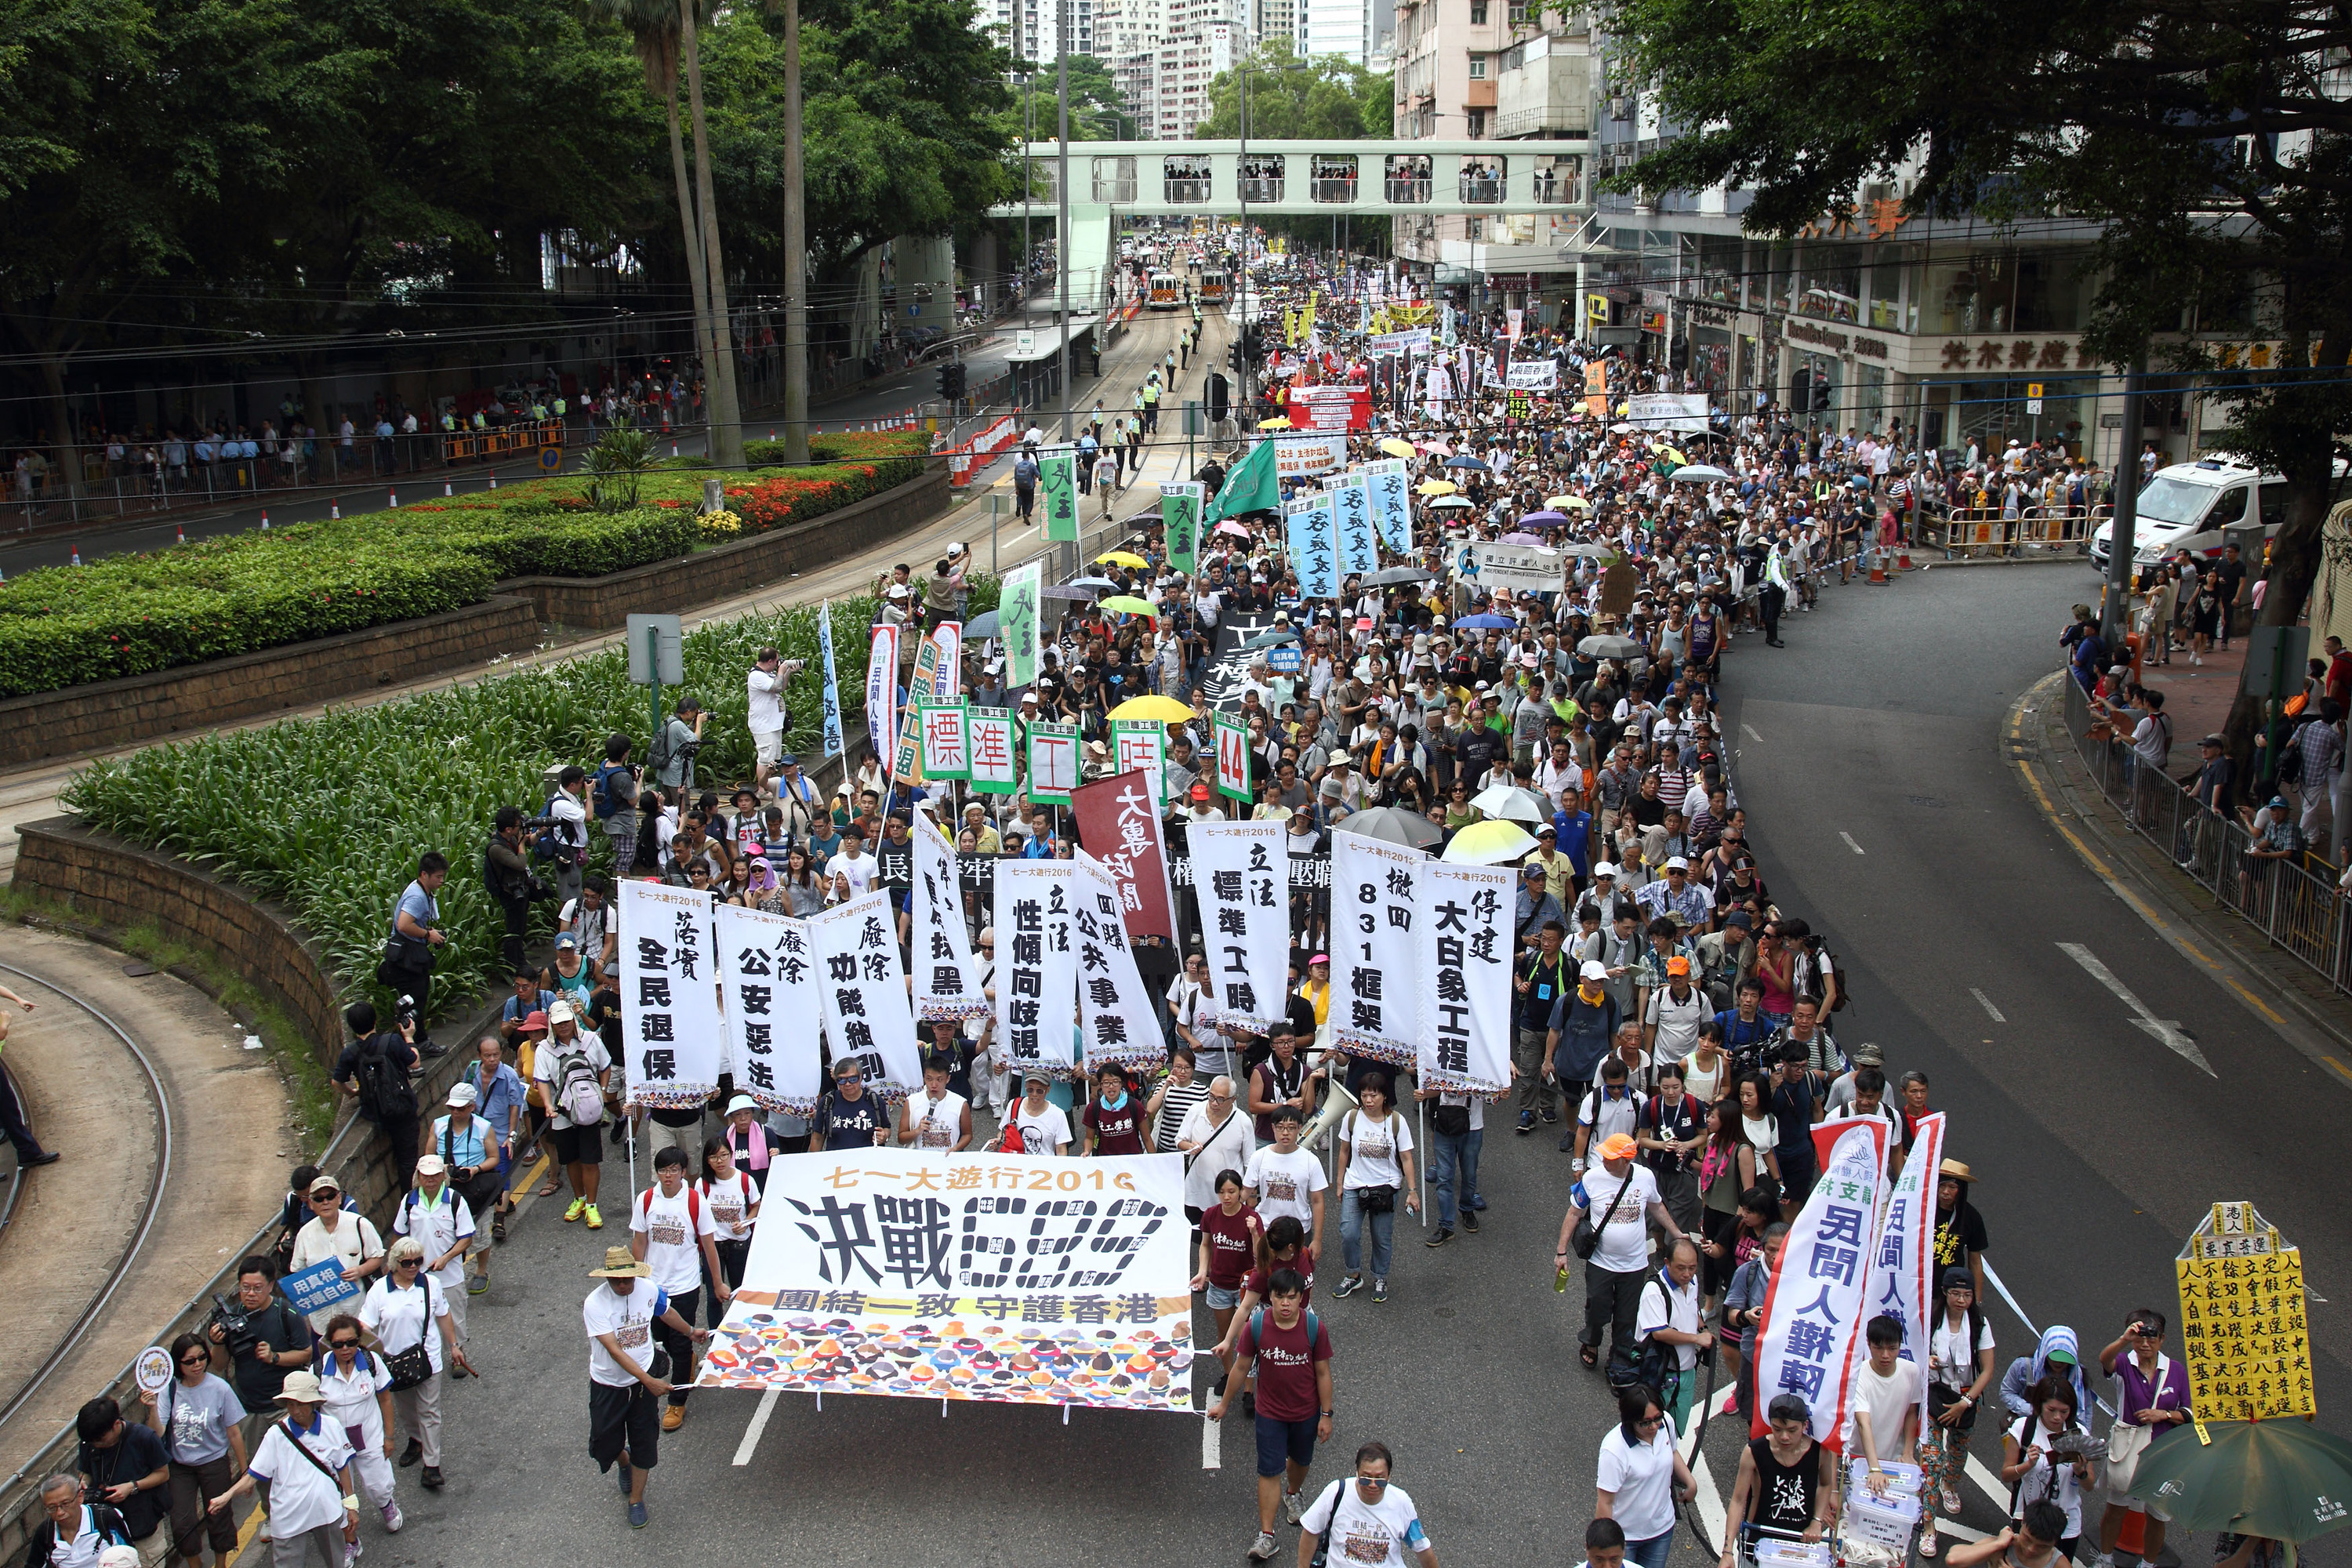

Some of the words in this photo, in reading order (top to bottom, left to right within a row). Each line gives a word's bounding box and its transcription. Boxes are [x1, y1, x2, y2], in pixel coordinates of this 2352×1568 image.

[1273, 652, 1295, 661] 用真相
[934, 695, 963, 706] 職工盟
[980, 707, 1008, 718] 職工盟
[1225, 715, 1245, 729] 職工盟
[926, 712, 963, 766] 標
[1045, 724, 1076, 735] 職工盟
[1130, 720, 1160, 731] 職工盟
[972, 722, 1008, 776] 準
[1036, 738, 1072, 790] 工
[1220, 729, 1244, 788] 44
[1206, 828, 1276, 837] 七一大遊行2016
[1011, 867, 1073, 877] 七一大遊行2016
[1248, 842, 1277, 908] 立法
[1433, 869, 1508, 884] 七一大遊行2016
[637, 890, 703, 909] 七一大遊行2016
[734, 911, 805, 930] 七一大遊行2016
[822, 898, 884, 925] 七一大遊行2016
[1047, 884, 1070, 953] 立法
[1385, 866, 1414, 933] 撤回
[671, 911, 700, 982] 落實
[1212, 869, 1258, 1014] 標準工時
[1468, 888, 1503, 964] 停建
[775, 928, 811, 985] 廢除
[858, 916, 892, 982] 廢除
[1351, 882, 1383, 1034] 831框架
[1009, 898, 1043, 1059] 性傾向歧視
[1075, 907, 1128, 1046] 公共事業
[1433, 899, 1470, 1074] 大白象工程
[637, 936, 677, 1081] 全民退保
[738, 947, 776, 1091] 公安惡法
[822, 1164, 1137, 1193] 七一大遊行2016
[2226, 1206, 2242, 1232] 港人
[2205, 1236, 2268, 1258] 要真普選
[292, 1267, 339, 1296] 用真相
[296, 1279, 354, 1311] 守護自由
[772, 1289, 961, 1319] 團結一致
[975, 1292, 1159, 1325] 守護香港
